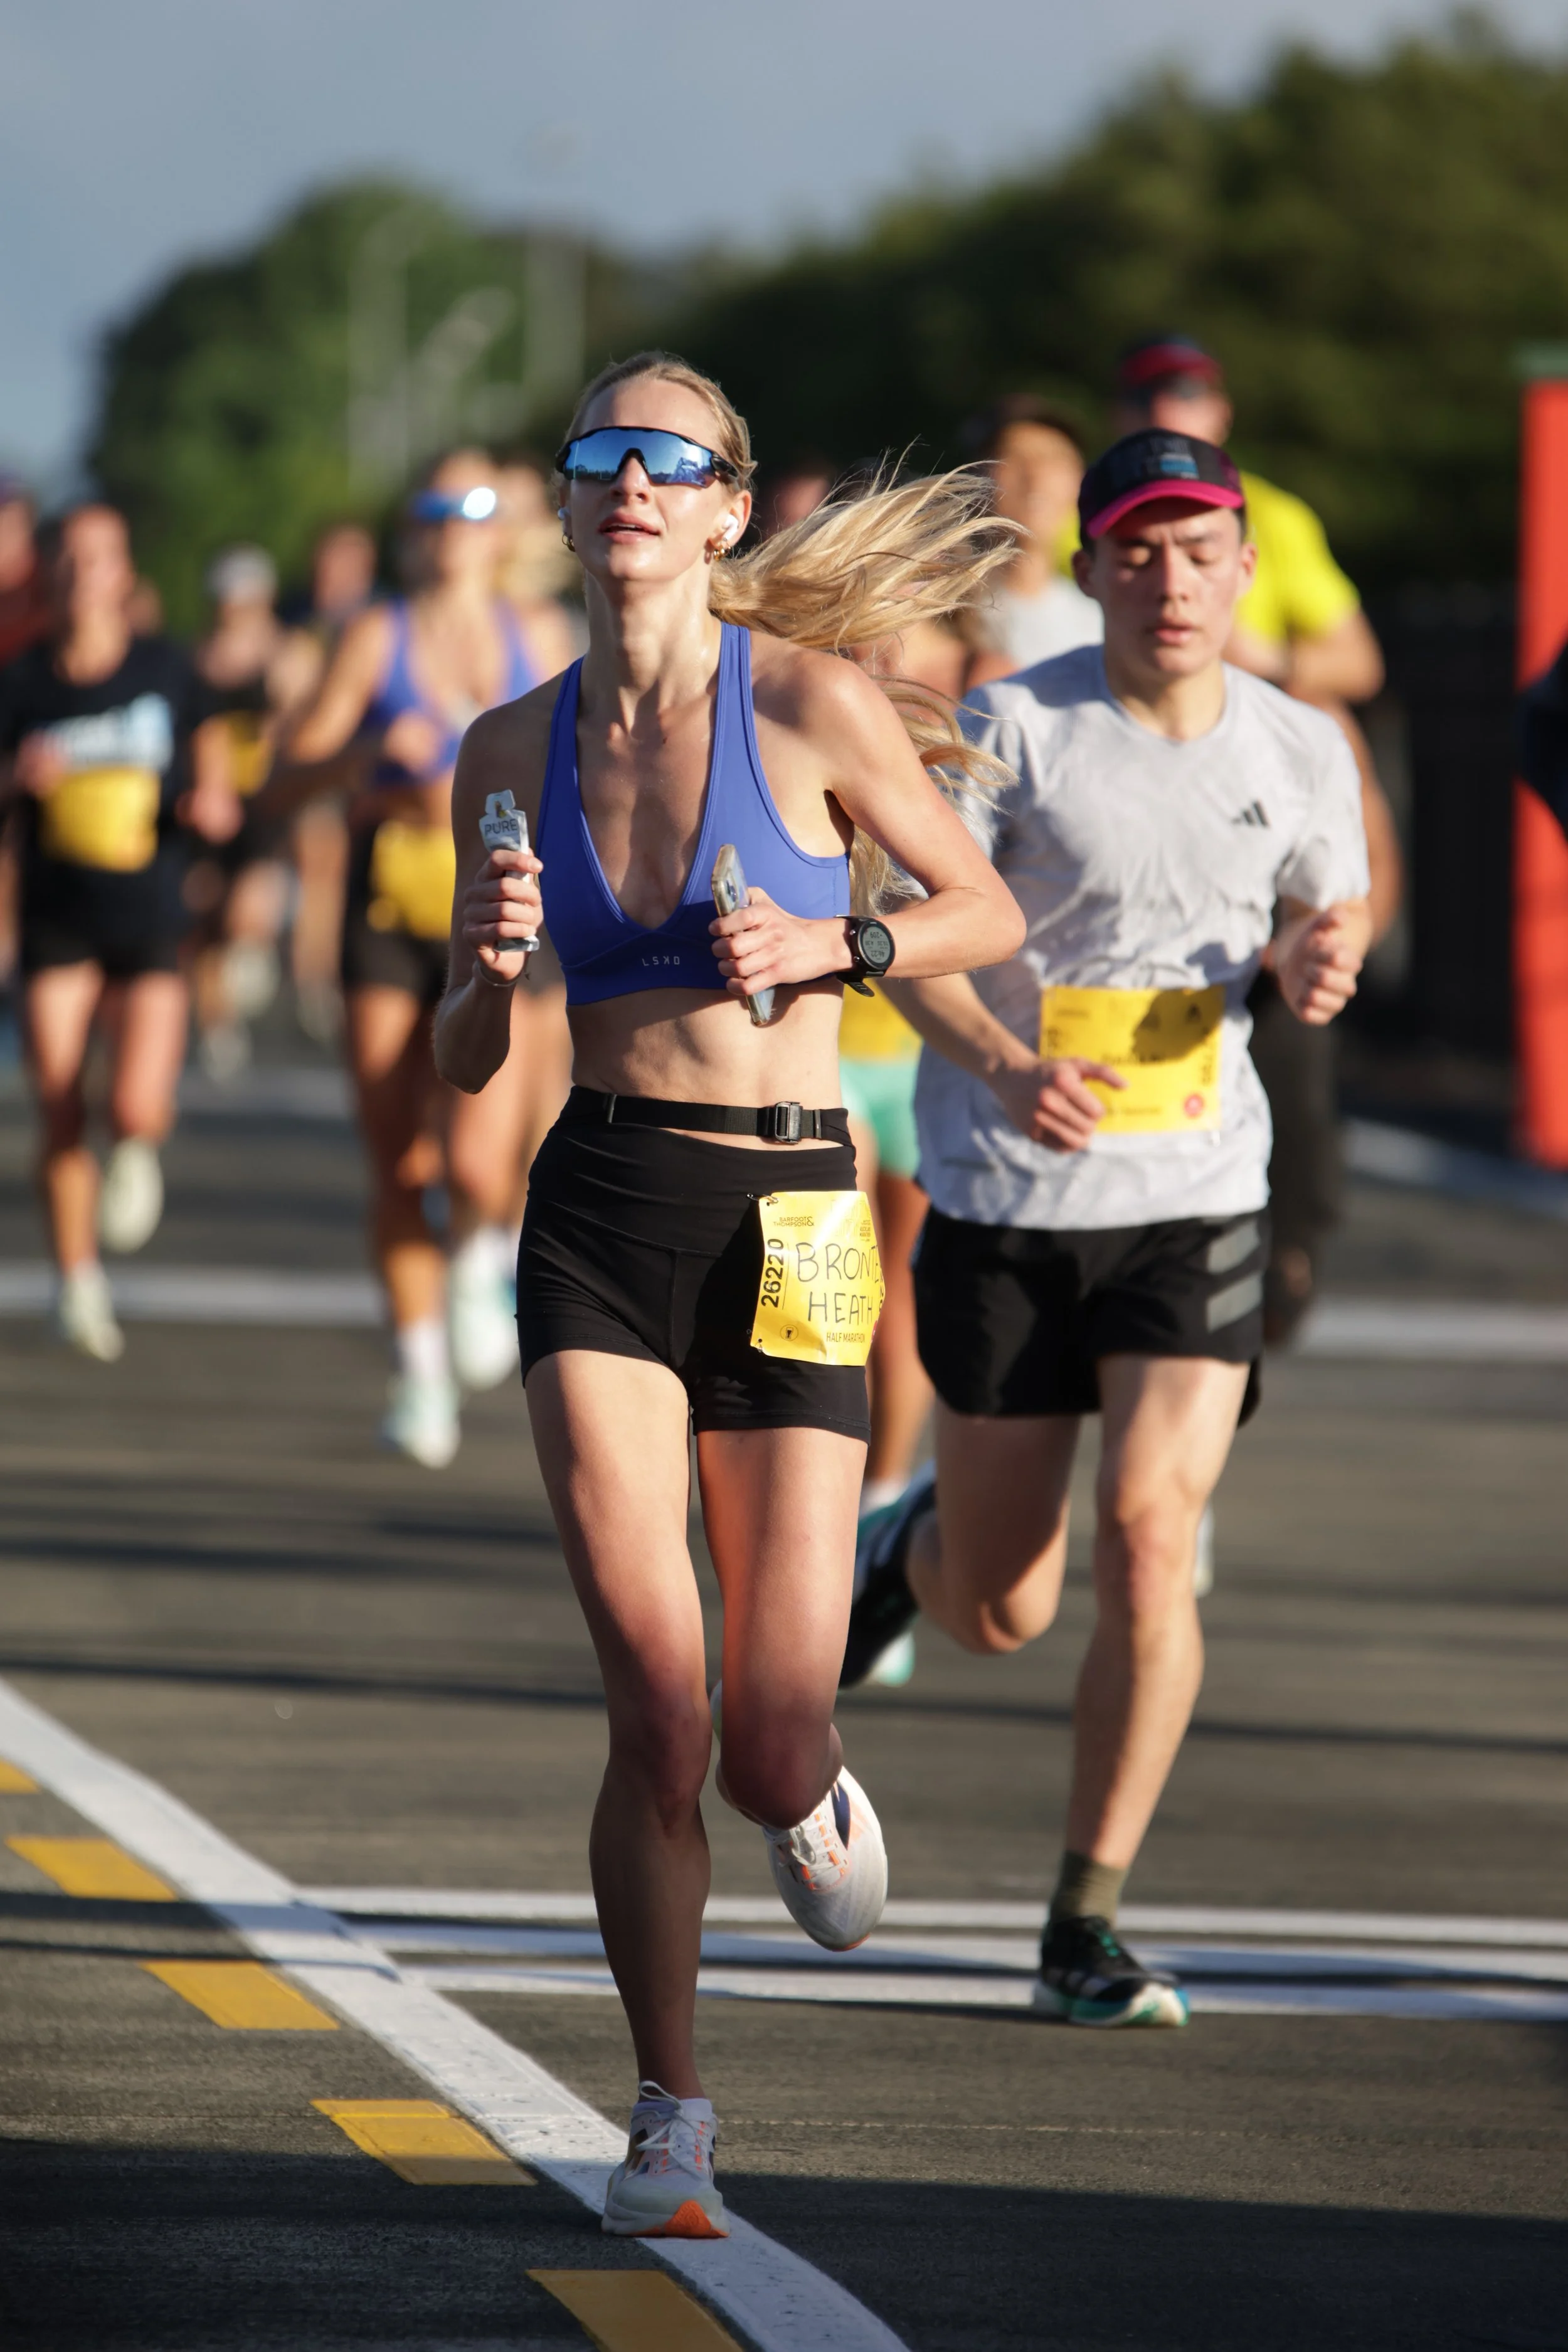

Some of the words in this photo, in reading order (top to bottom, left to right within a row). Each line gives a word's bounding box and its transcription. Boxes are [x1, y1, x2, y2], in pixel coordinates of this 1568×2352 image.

[484, 818, 518, 837] PURE
[761, 1239, 784, 1308] 26220
[808, 1291, 873, 1325] HEATH
[826, 1332, 842, 1343] HALF
[843, 1332, 865, 1343] MARATHON
